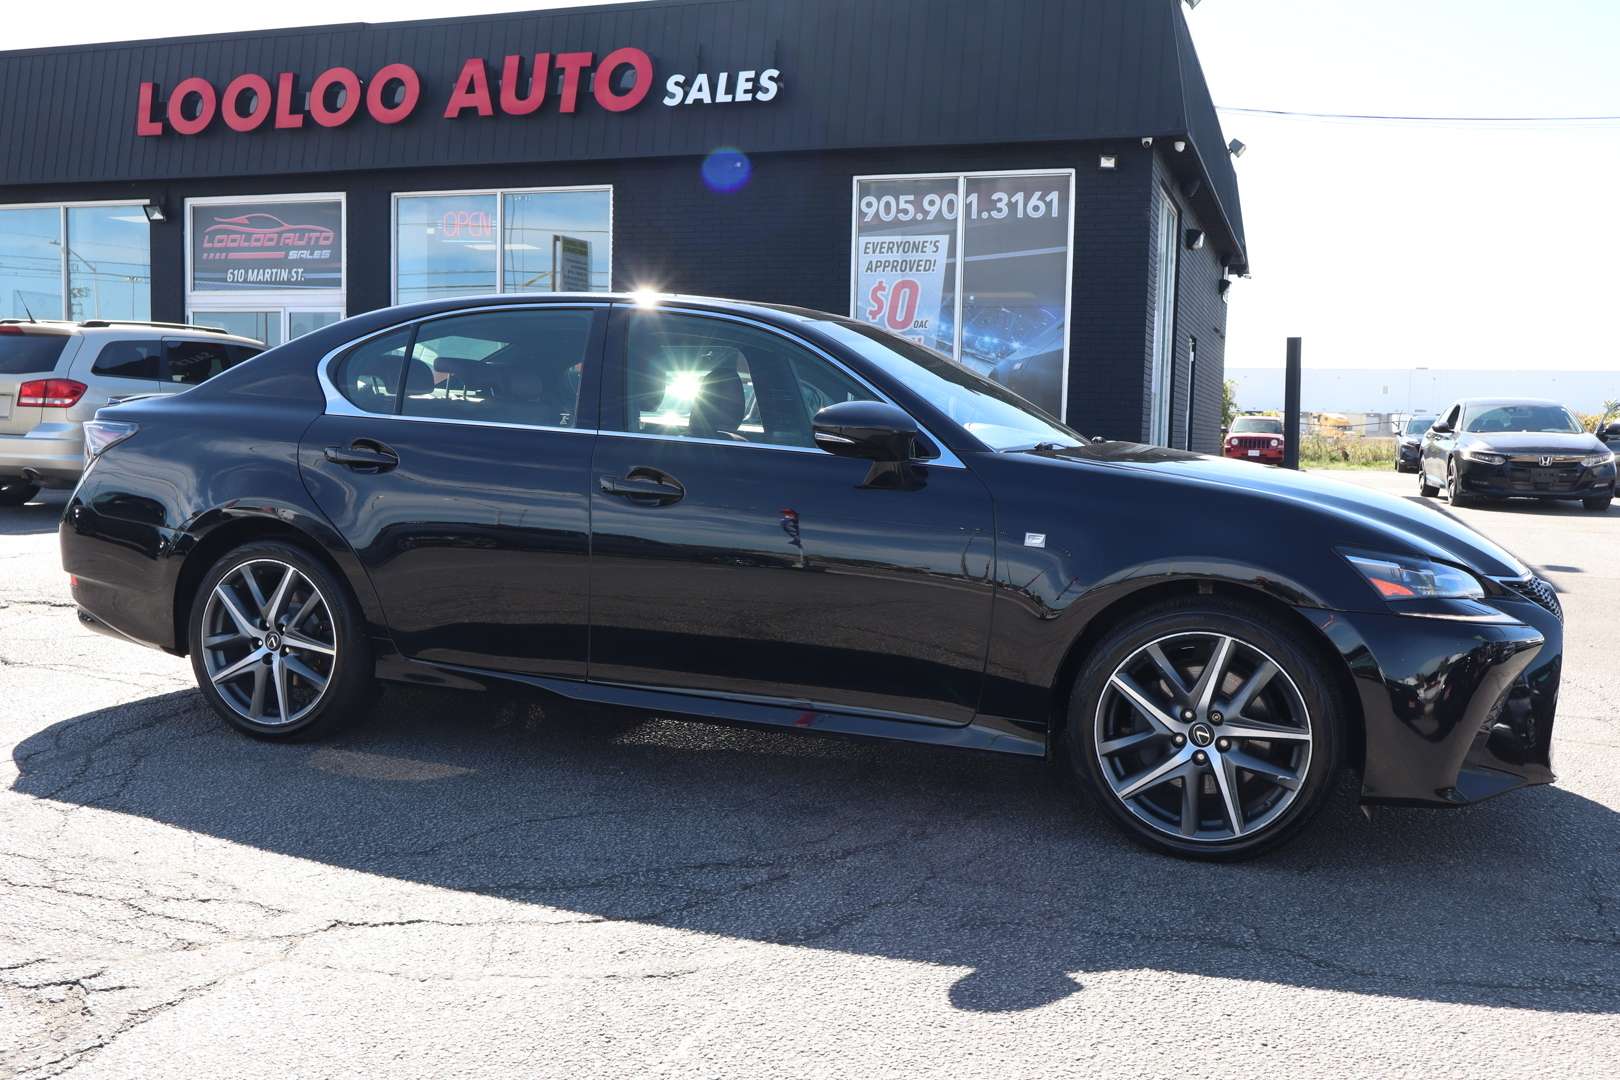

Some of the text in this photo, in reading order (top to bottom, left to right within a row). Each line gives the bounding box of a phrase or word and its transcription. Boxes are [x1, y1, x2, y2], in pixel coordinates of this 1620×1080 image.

[136, 47, 781, 137] LOOLOO AUTO SALES
[860, 190, 1059, 222] 905.901.3161
[443, 211, 493, 237] OPEN
[203, 232, 336, 248] LOOLOO AUTO
[863, 240, 940, 254] EVERYONE'S
[288, 250, 332, 260] SALES
[865, 259, 937, 273] APPROVED!
[226, 268, 305, 282] 610 MARTIN ST.
[868, 279, 920, 331] $0
[913, 320, 929, 329] OAC
